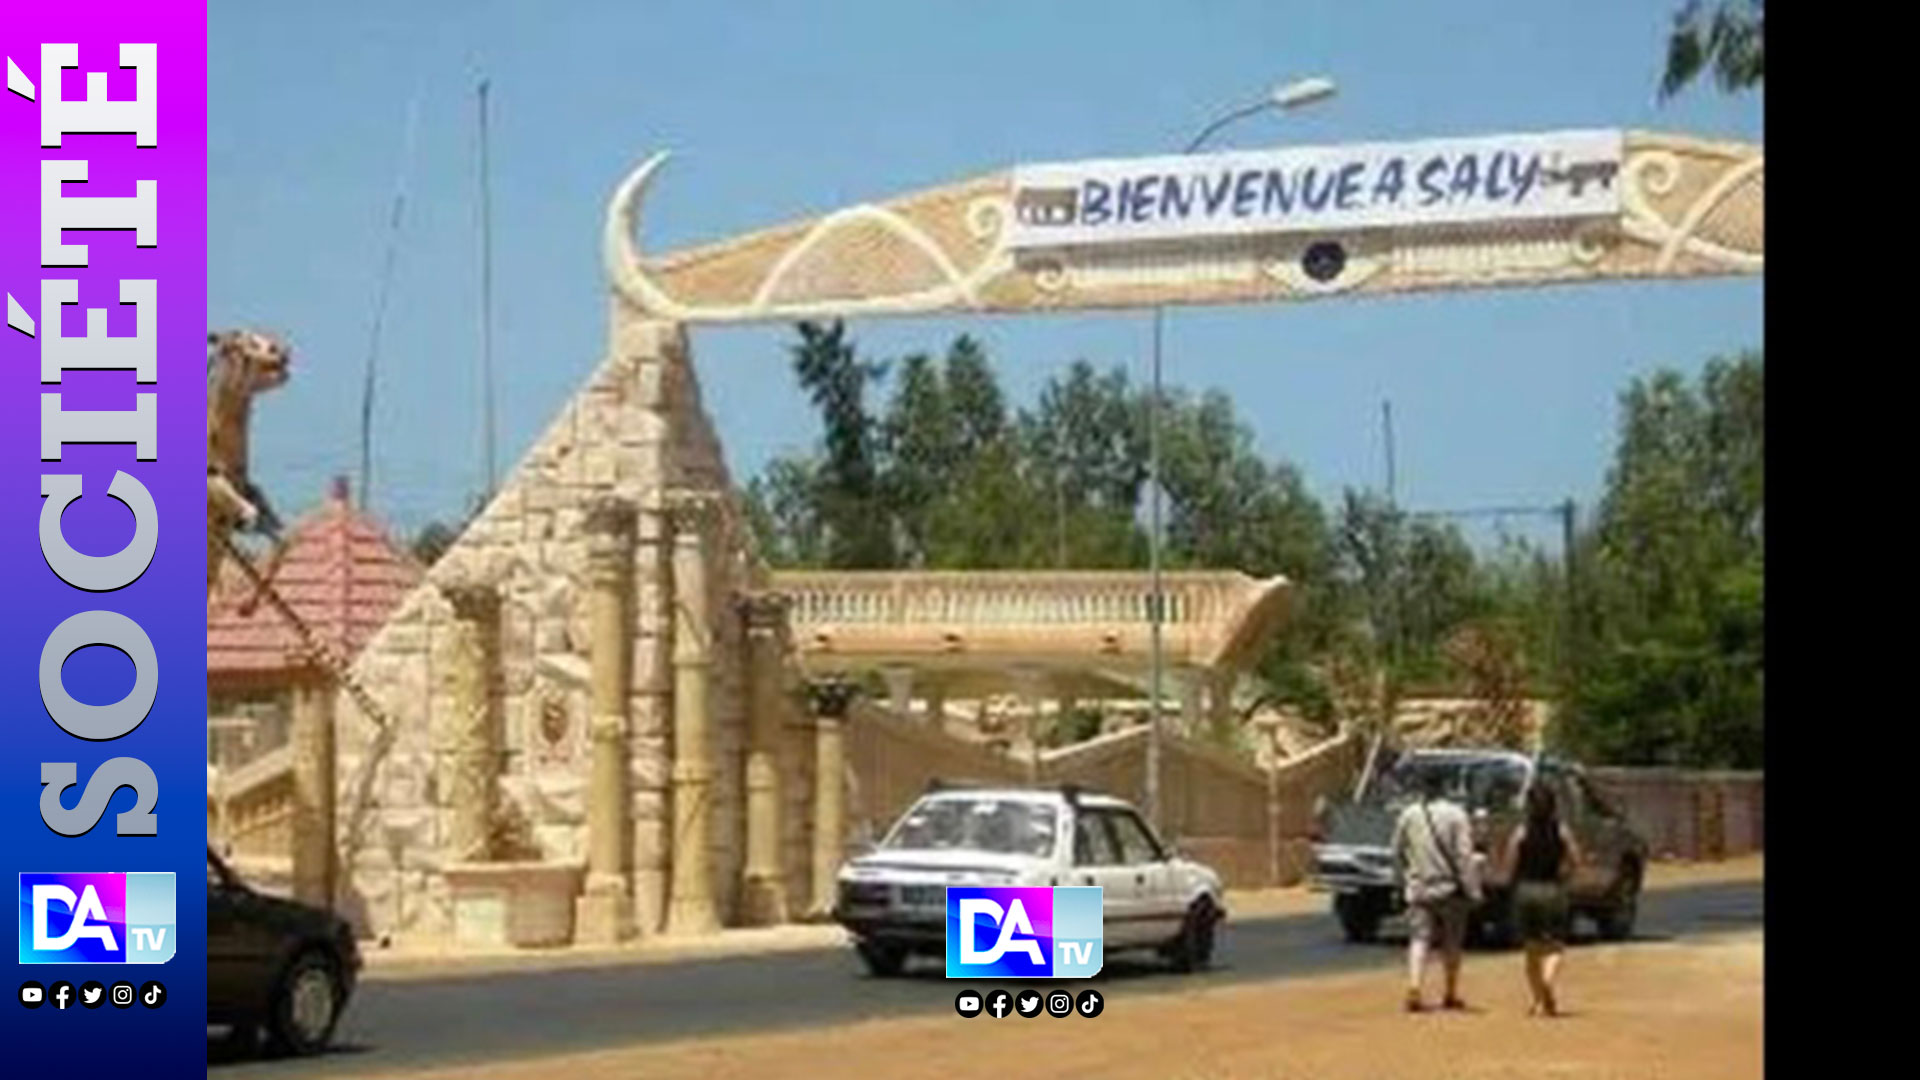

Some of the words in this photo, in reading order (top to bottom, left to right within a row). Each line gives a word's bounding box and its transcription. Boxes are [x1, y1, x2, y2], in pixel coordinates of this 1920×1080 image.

[1081, 163, 1364, 225] BIENVENUE
[1372, 157, 1404, 202] A
[1416, 150, 1540, 205] SALY
